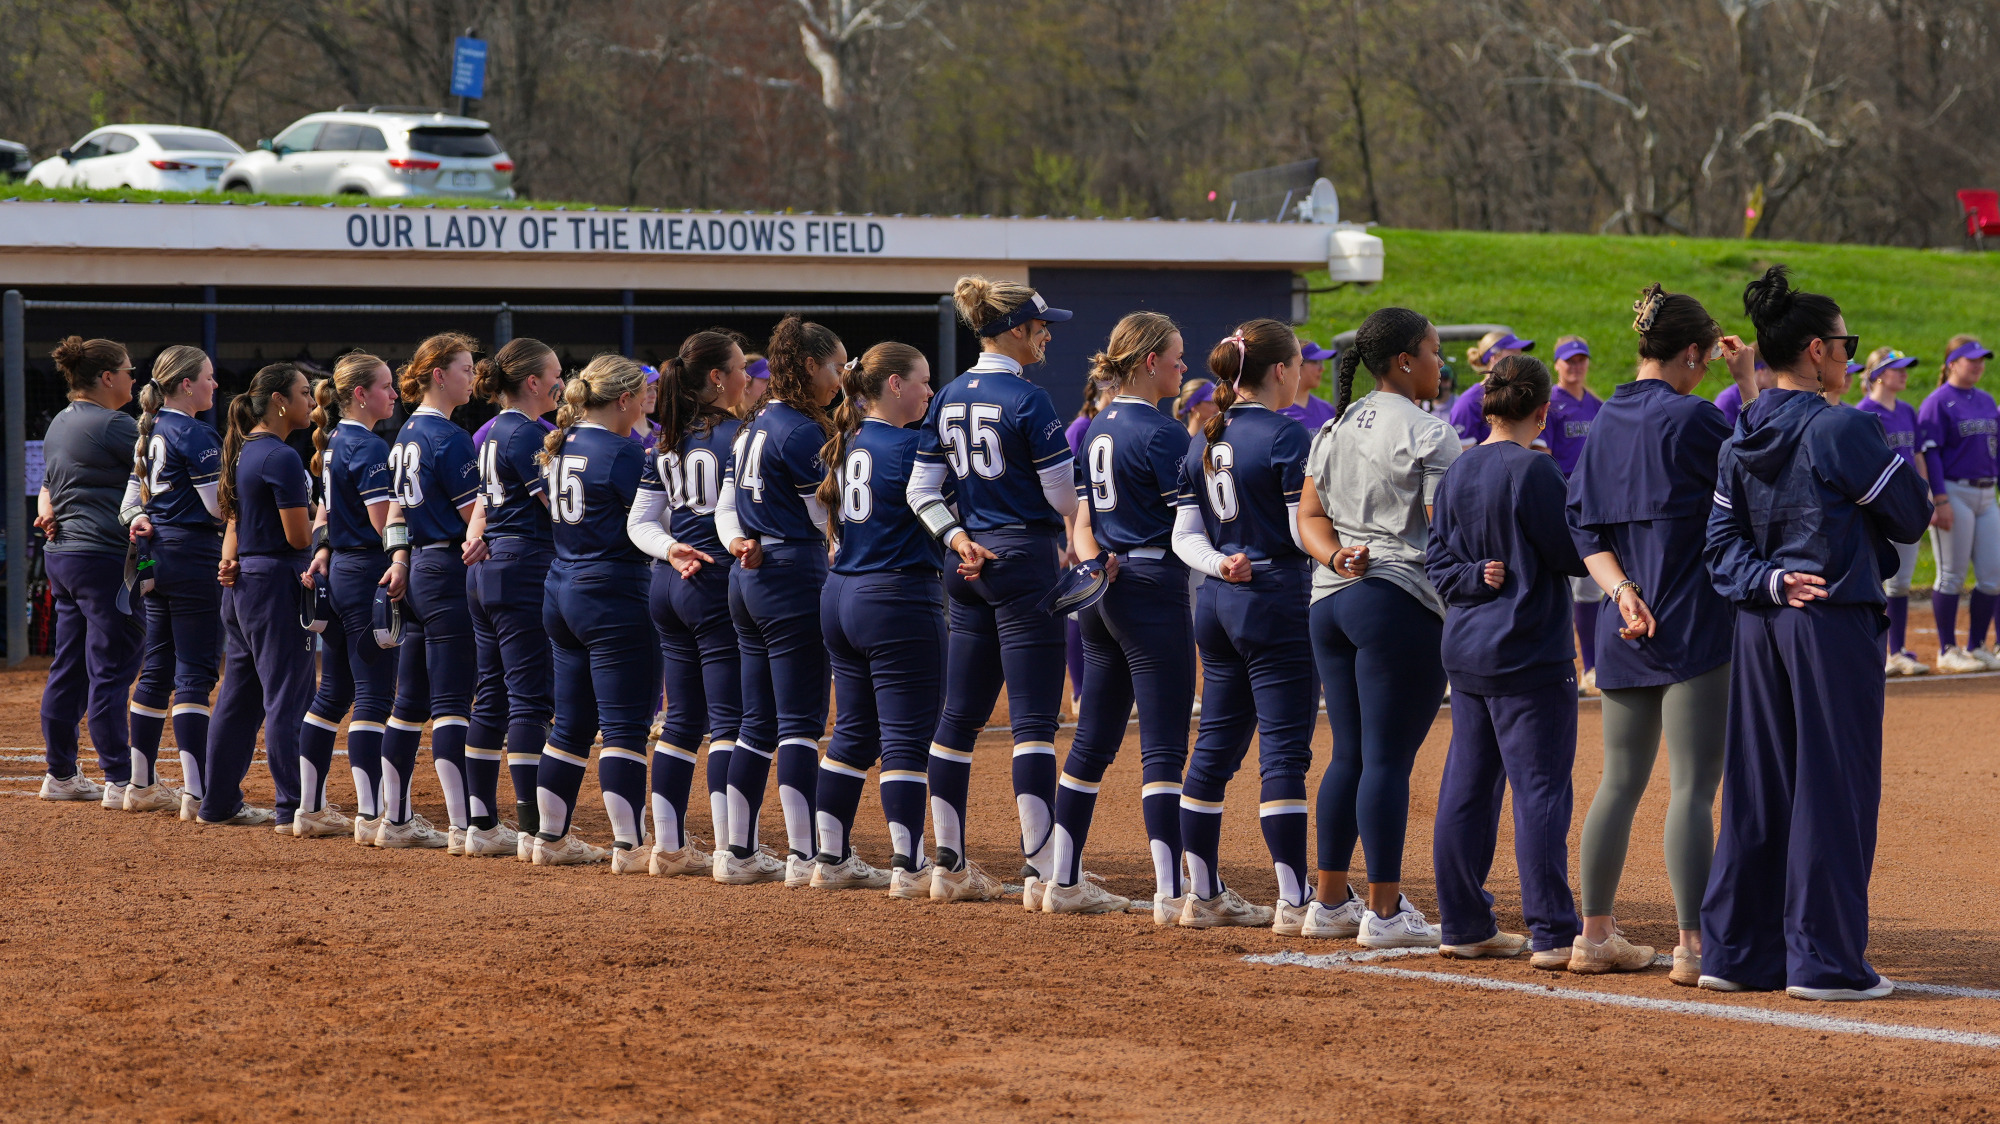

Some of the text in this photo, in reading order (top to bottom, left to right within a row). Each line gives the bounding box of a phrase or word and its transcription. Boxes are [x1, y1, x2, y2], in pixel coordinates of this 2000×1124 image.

[346, 213, 885, 254] OUR LADY OF THE MEADOWS FIELD
[938, 402, 1006, 480] 55
[1356, 409, 1377, 430] 42
[387, 441, 425, 509] 23
[542, 454, 587, 525] 15
[732, 428, 768, 503] 14
[1087, 433, 1118, 513] 9
[1203, 441, 1240, 523] 6
[305, 636, 312, 652] 3
